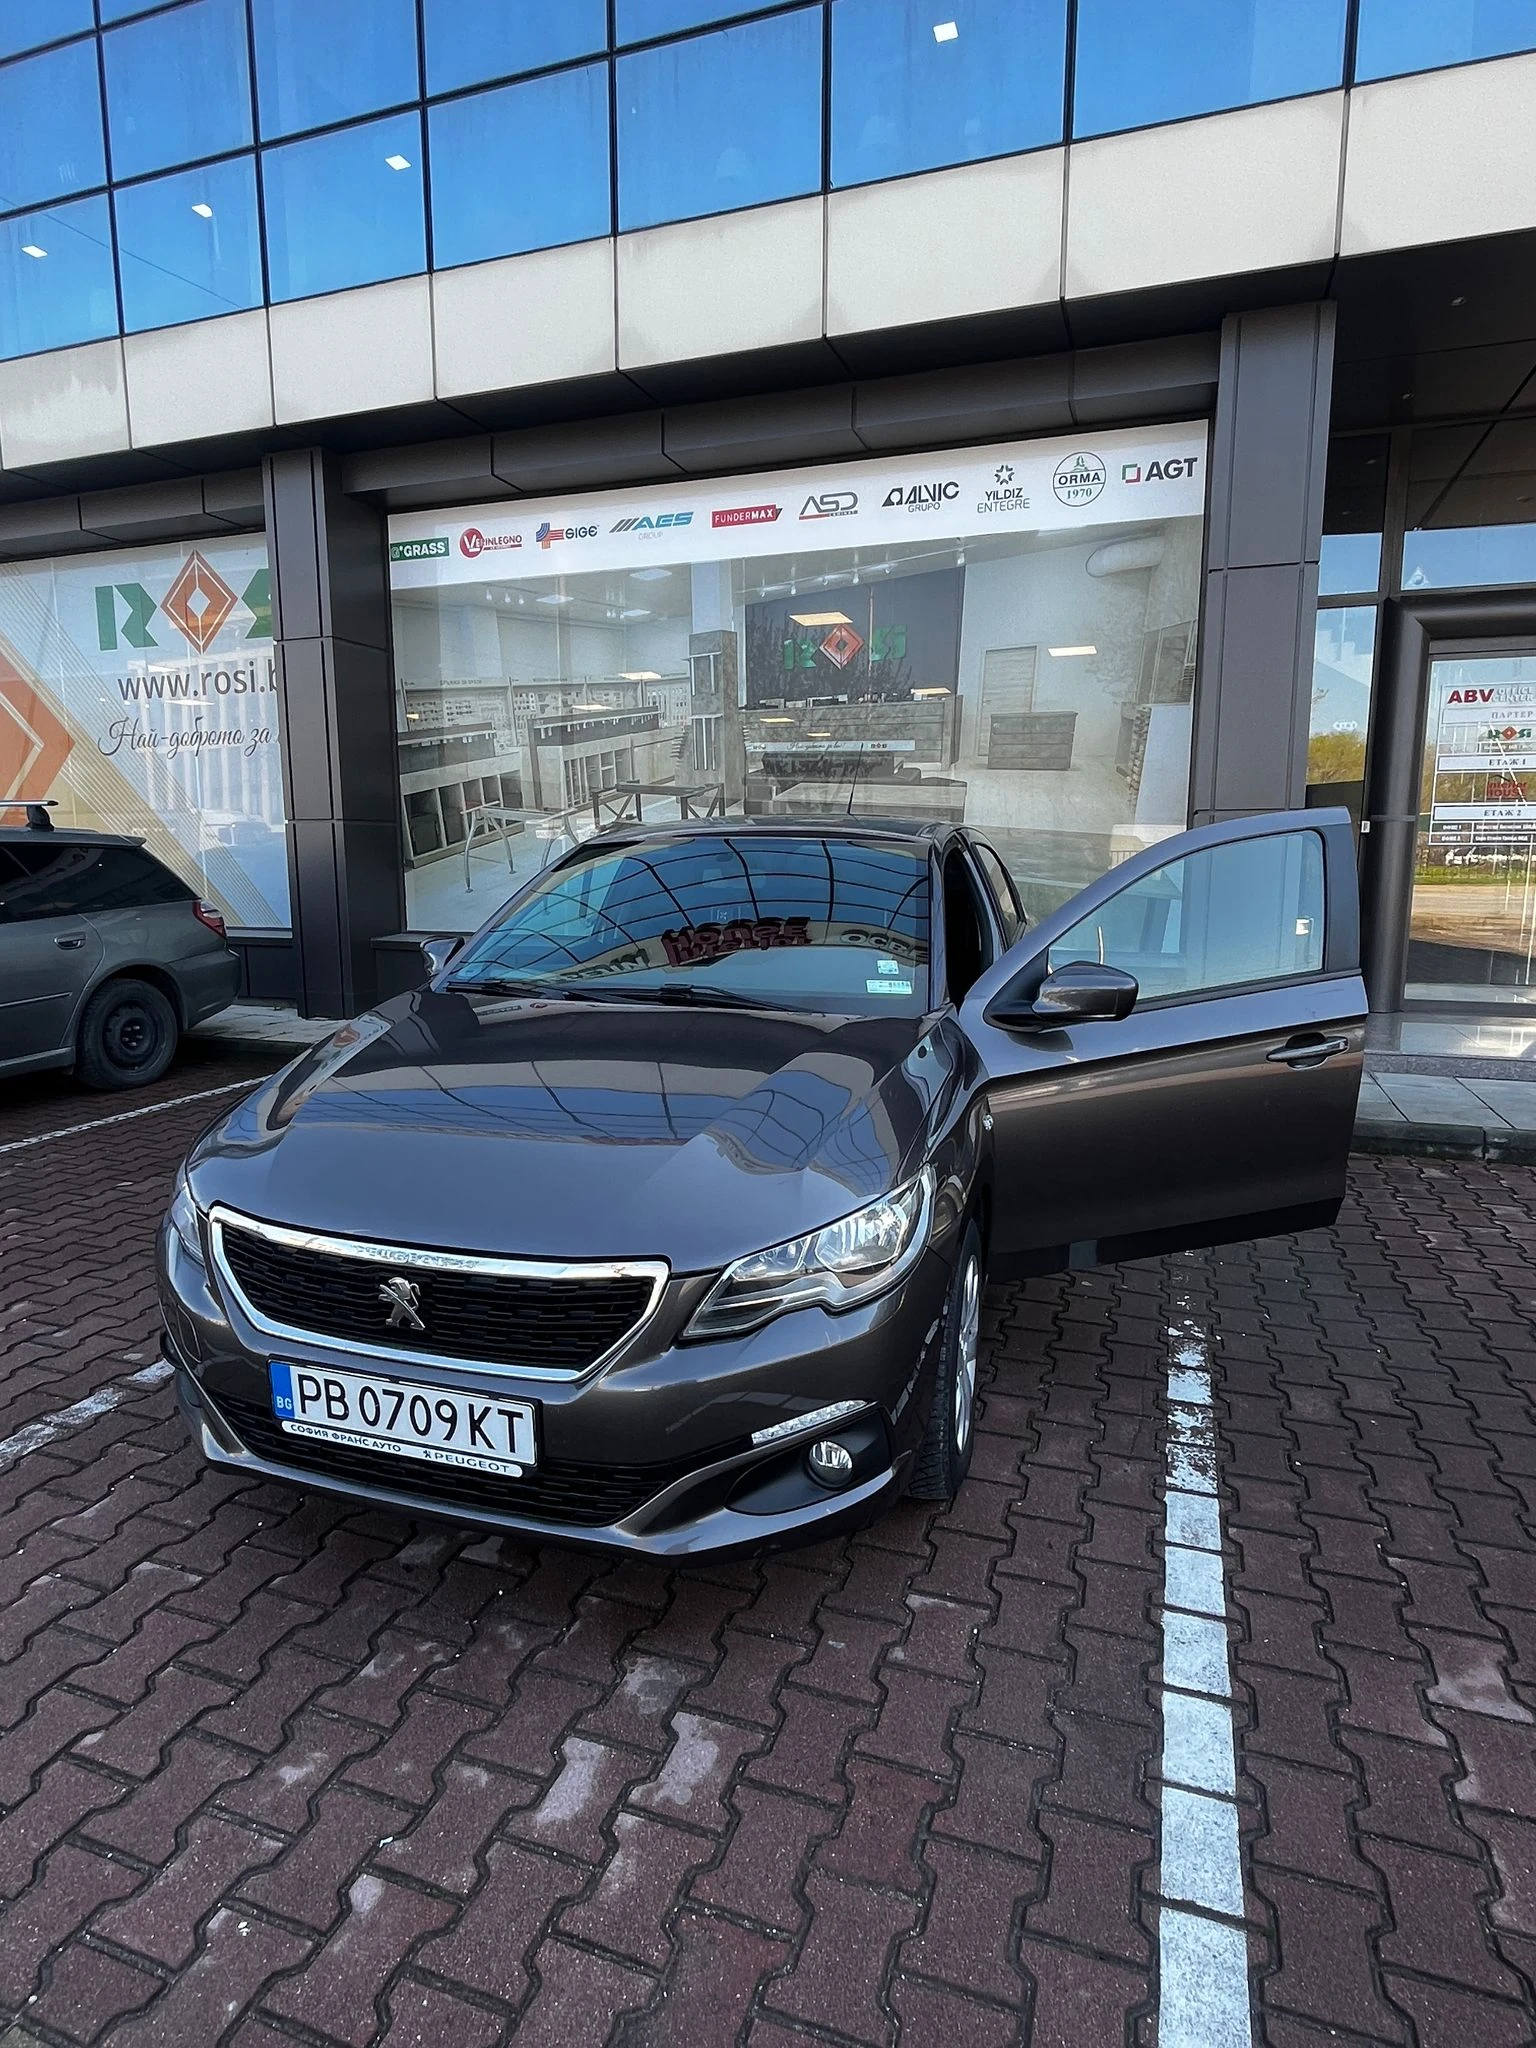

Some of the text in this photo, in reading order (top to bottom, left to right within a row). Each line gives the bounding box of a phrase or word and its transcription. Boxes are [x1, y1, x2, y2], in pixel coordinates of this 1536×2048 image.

[1145, 457, 1198, 481] AGT
[1058, 472, 1101, 485] ORMA
[905, 481, 960, 504] ALVIC
[985, 487, 1023, 501] YILDIZ
[1066, 487, 1092, 499] 1970
[908, 502, 941, 513] GRUPO
[977, 498, 1030, 513] ENTEGRE
[631, 511, 694, 530] AES
[714, 508, 774, 524] FUNDERMAX
[565, 525, 598, 540] SIGE
[404, 541, 445, 557] GRASS
[1447, 688, 1495, 704] ABV
[1491, 710, 1534, 719] ПАРТЕР
[97, 716, 272, 760] Най-доброто за
[1489, 758, 1520, 767] ЕТАЖ
[1484, 809, 1522, 817] ЕТАЖ 2
[276, 1396, 292, 1410] BG
[297, 1373, 525, 1454] PB 0709 KT
[290, 1424, 402, 1453] СОФИЯ ФРАНС АУТО
[434, 1452, 510, 1474] PEUGEOT
